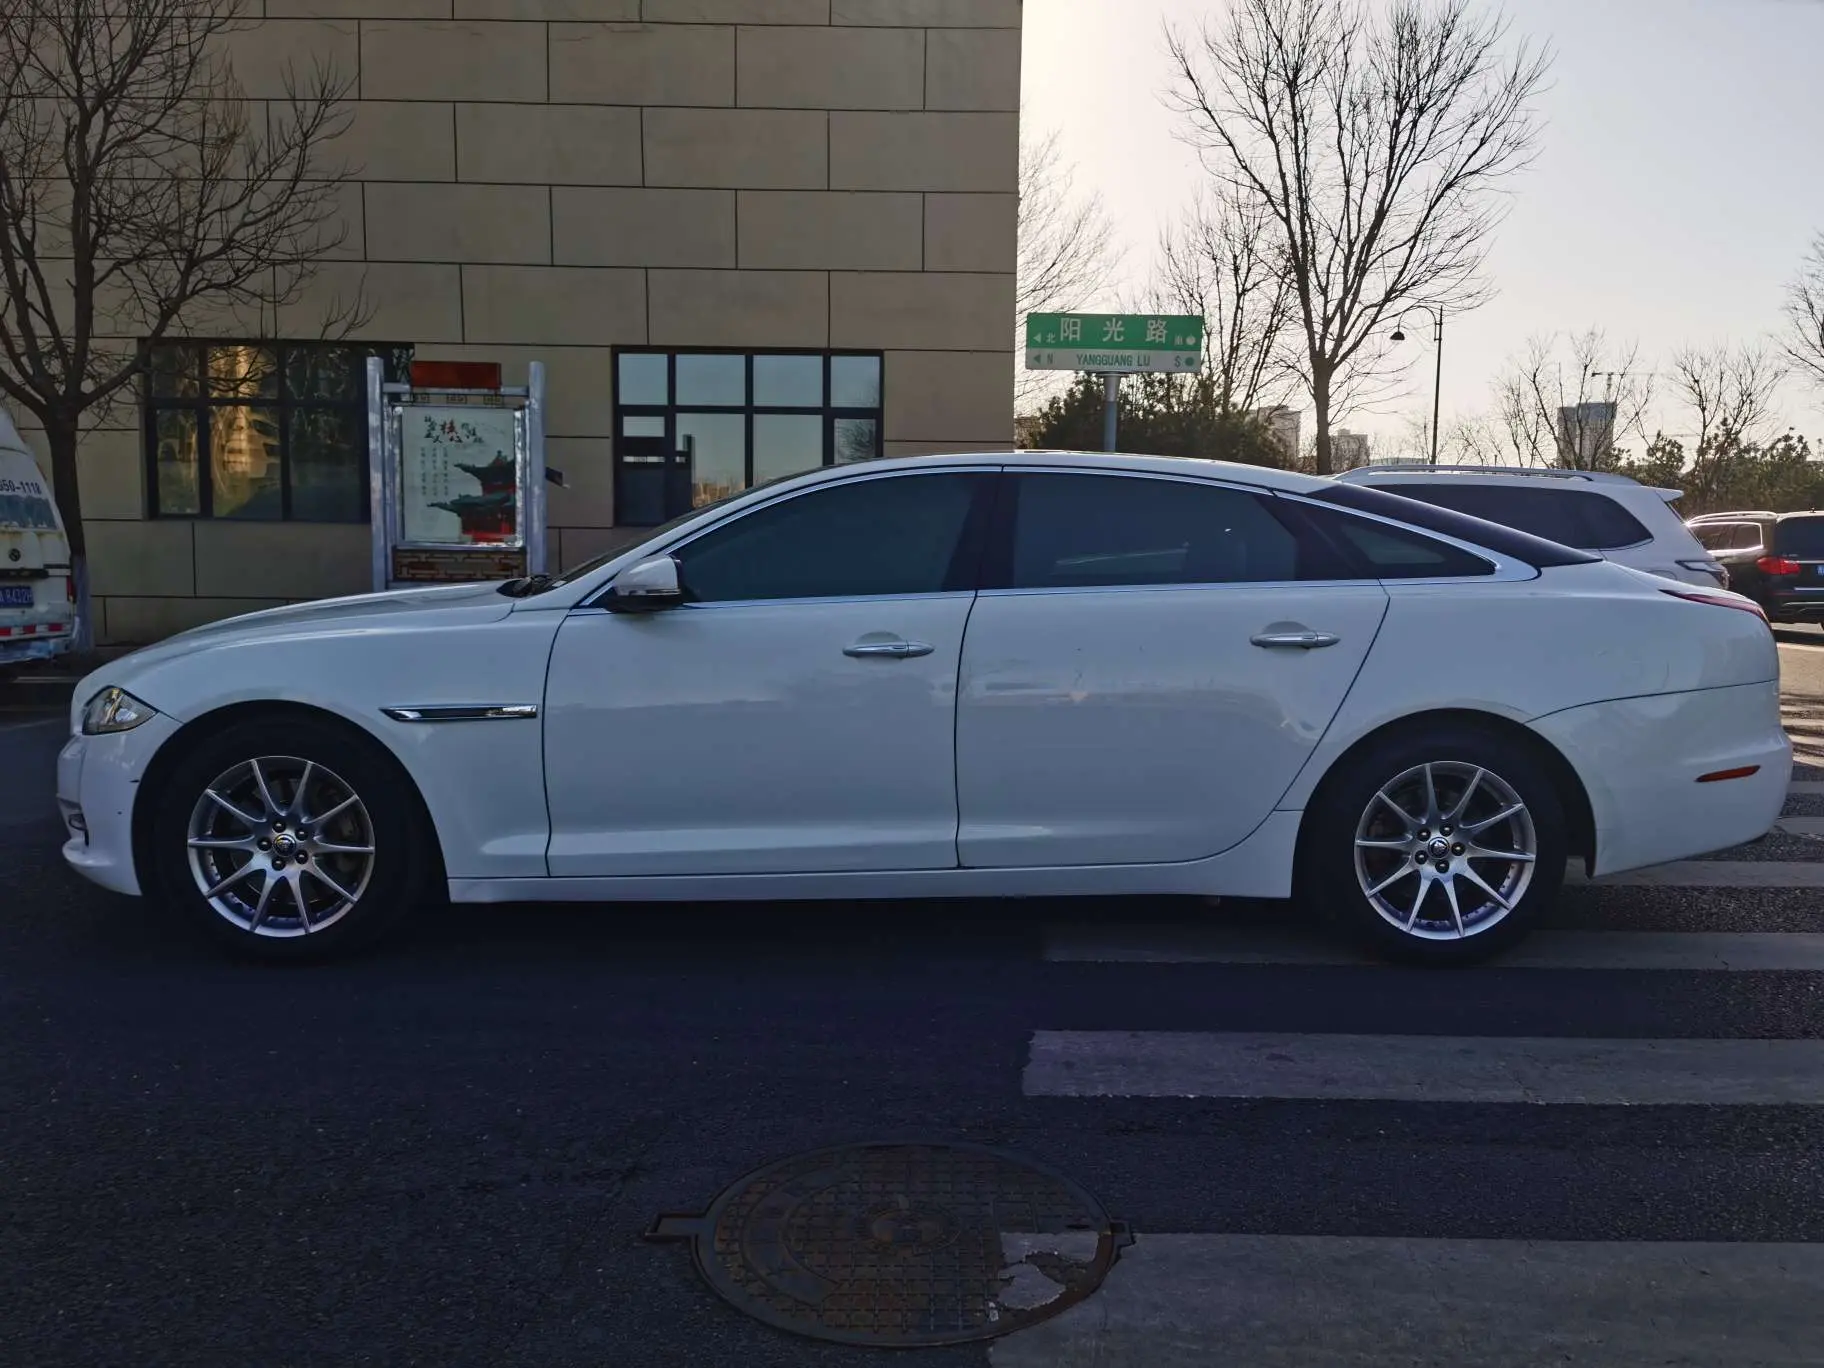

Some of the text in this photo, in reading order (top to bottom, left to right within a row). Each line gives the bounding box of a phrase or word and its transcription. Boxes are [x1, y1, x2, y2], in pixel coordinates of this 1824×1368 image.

[1060, 317, 1168, 343] 阳光路
[1046, 333, 1056, 343] 北
[1076, 354, 1150, 367] YANGGUANG LU
[1174, 355, 1181, 367] S
